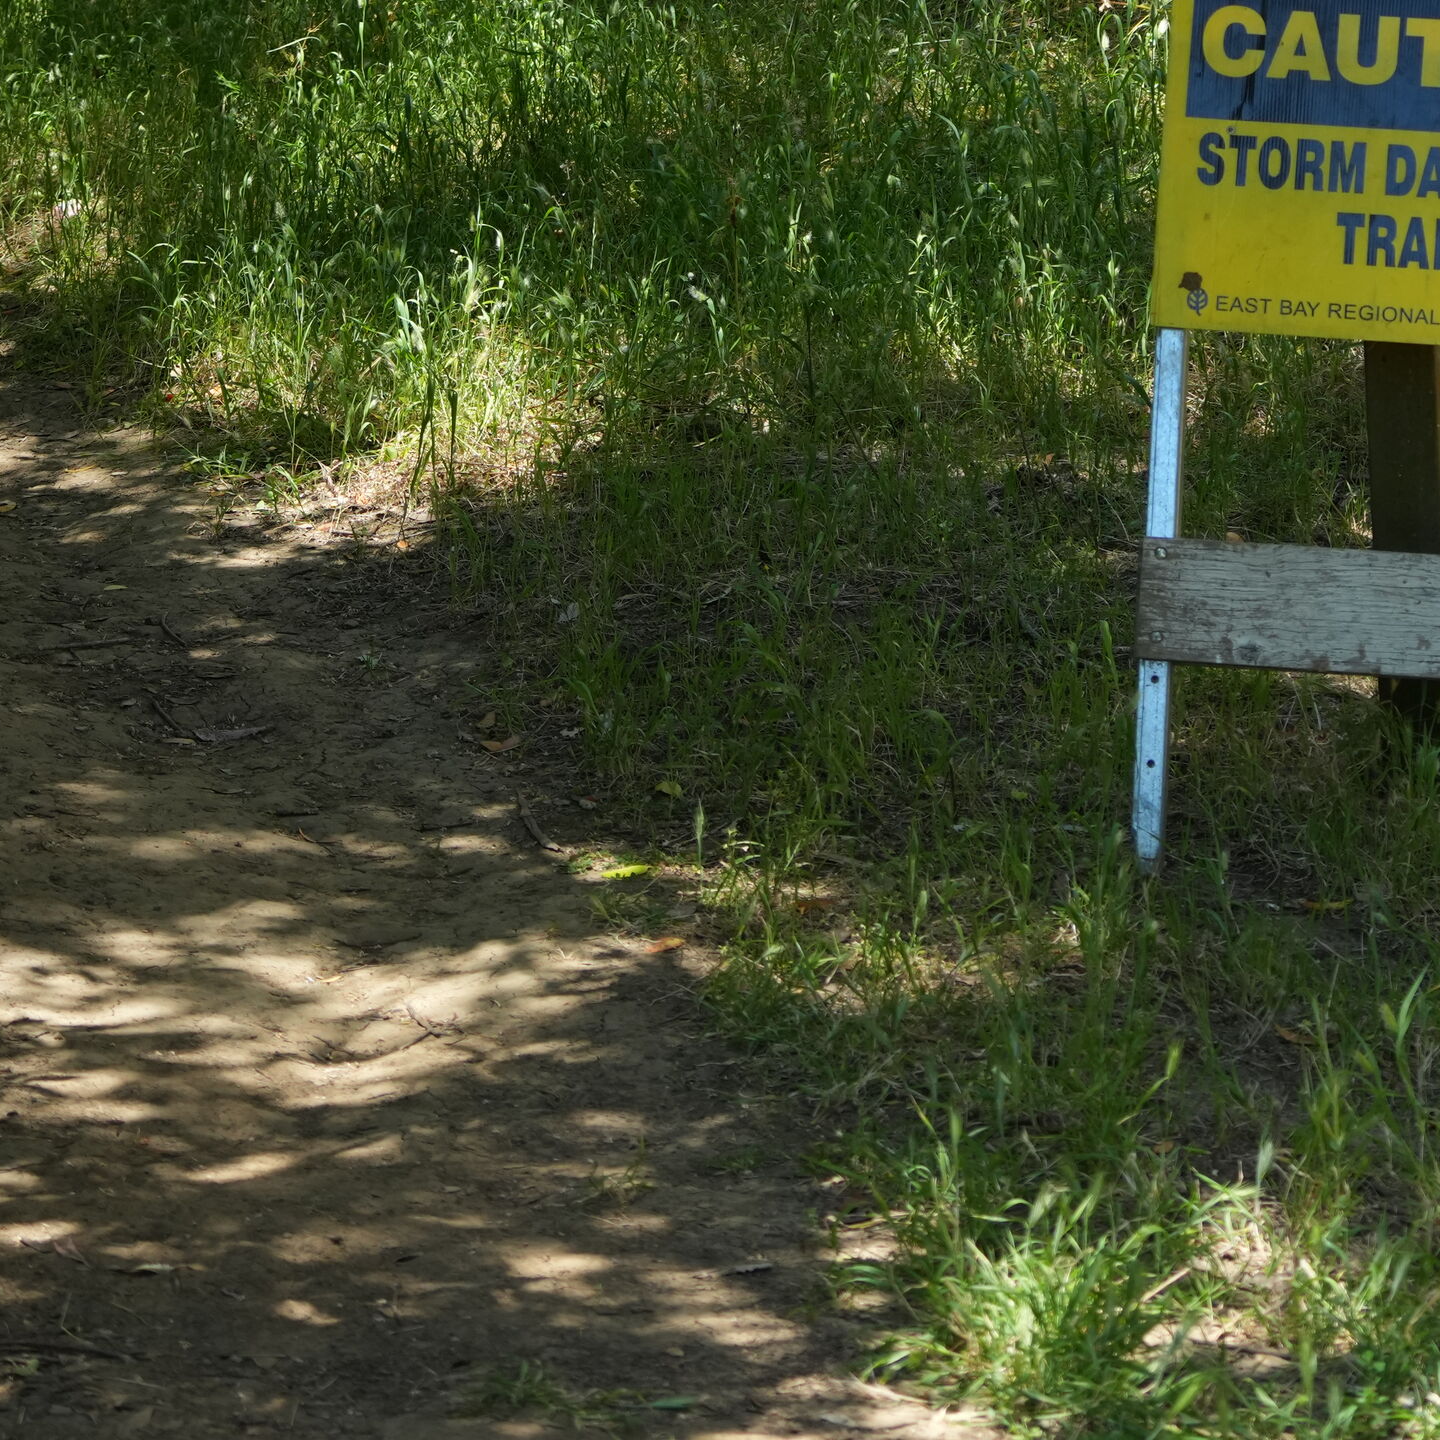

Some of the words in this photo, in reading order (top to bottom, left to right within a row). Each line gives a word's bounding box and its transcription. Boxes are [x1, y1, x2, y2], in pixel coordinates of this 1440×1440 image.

[1196, 131, 1367, 196] STORM
[1215, 295, 1271, 315] EAST
[1279, 298, 1321, 318] BAY
[1327, 301, 1440, 326] REGIONAL
